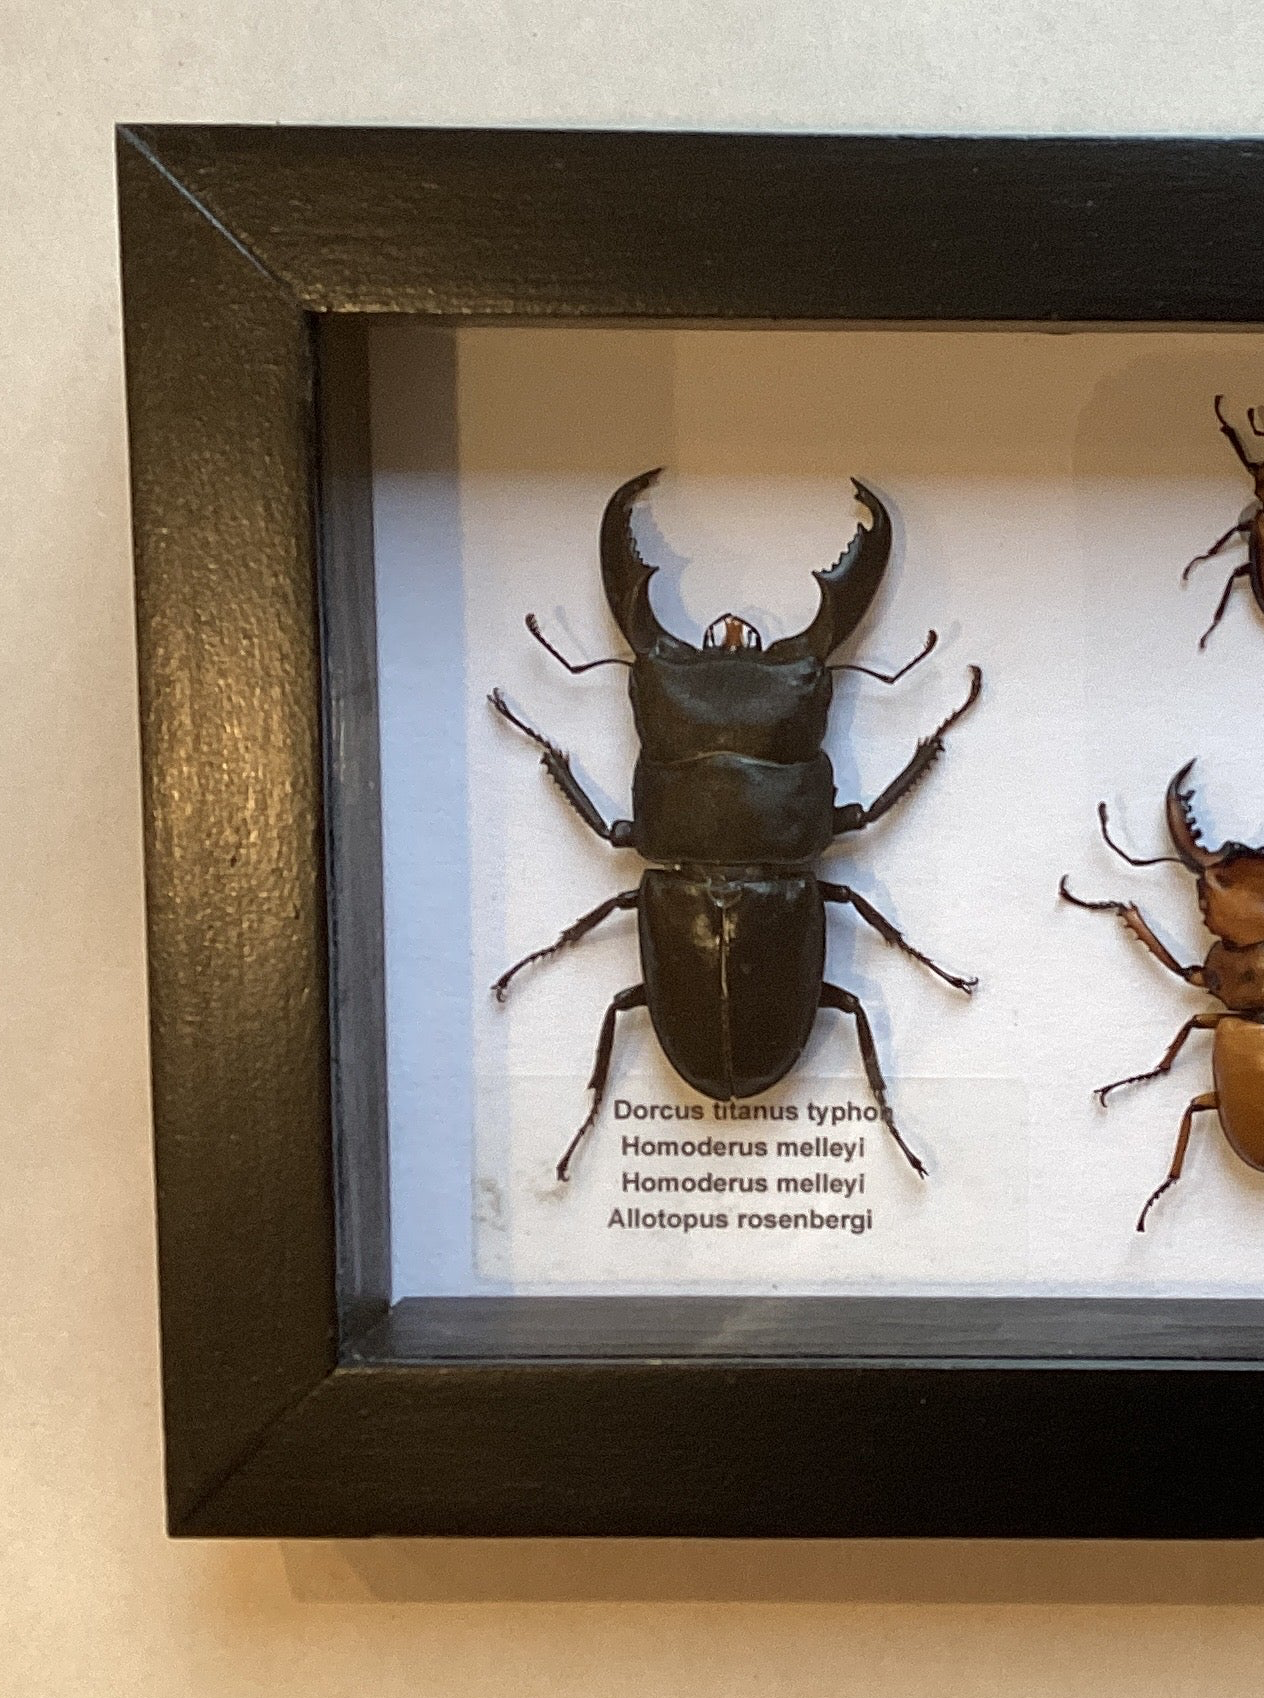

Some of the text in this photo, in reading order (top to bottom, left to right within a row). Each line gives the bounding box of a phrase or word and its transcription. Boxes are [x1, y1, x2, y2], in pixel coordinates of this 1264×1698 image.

[613, 1100, 705, 1121] Dorcus
[713, 1101, 799, 1121] titanus
[621, 1136, 865, 1162] Homoderus melleyi
[621, 1172, 865, 1198] Homoderus melleyi
[607, 1208, 873, 1234] Allotopus rosenbergi
